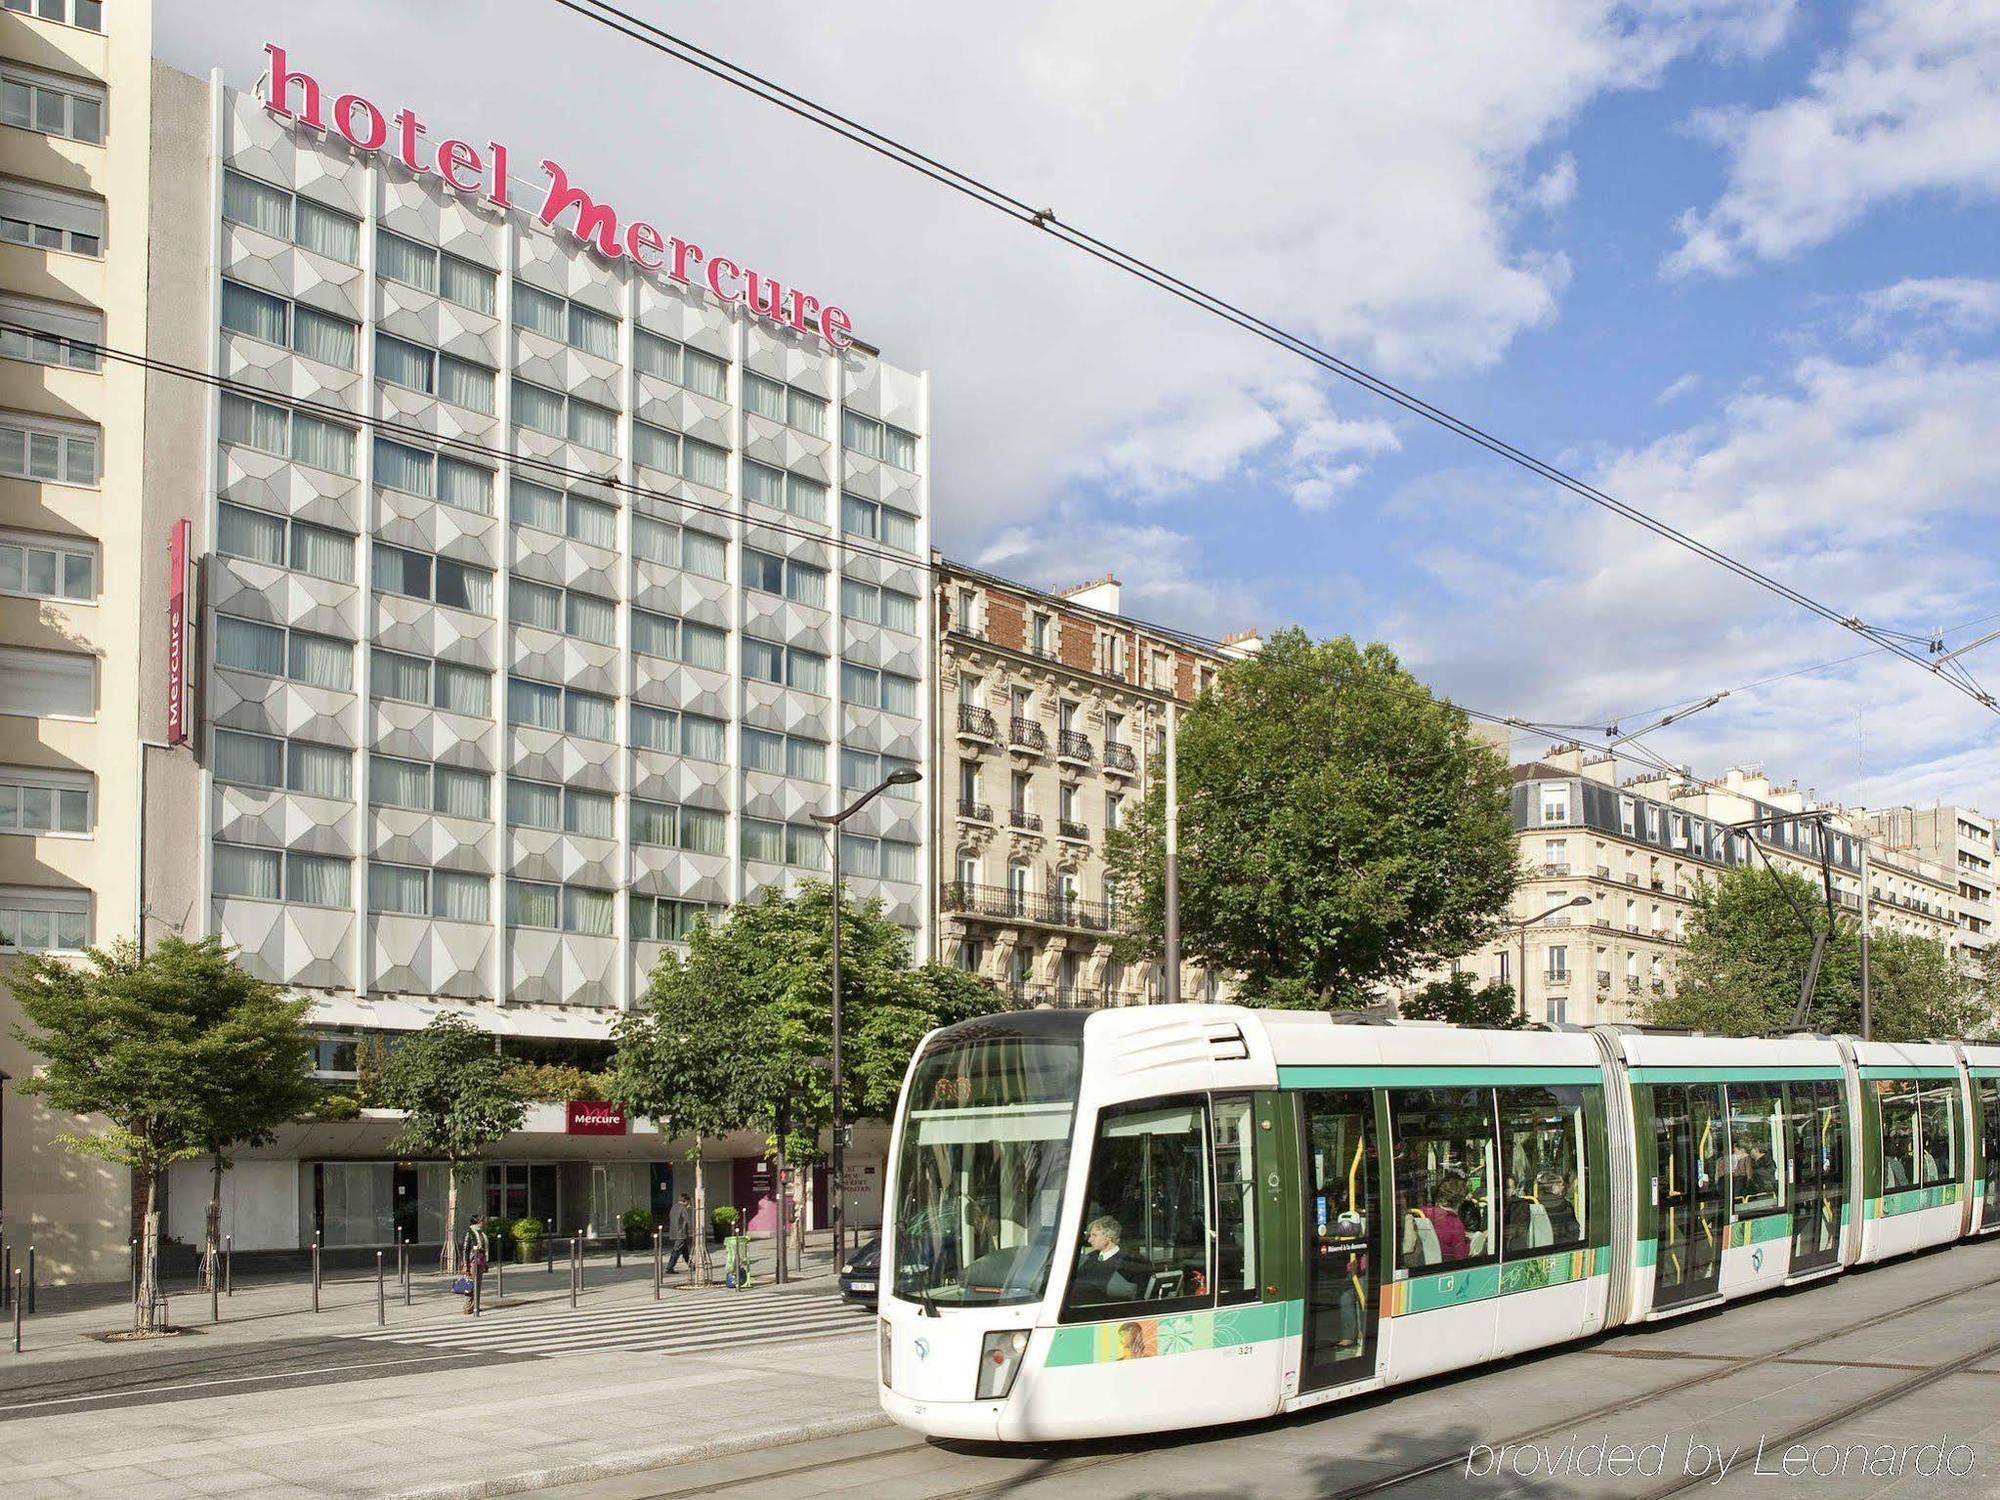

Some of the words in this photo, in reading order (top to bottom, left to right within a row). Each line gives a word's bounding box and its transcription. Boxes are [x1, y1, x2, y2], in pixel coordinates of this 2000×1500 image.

[264, 42, 514, 209] hotel
[169, 612, 180, 726] Mercure
[574, 1114, 621, 1125] Mercure
[1238, 1346, 1253, 1355] 321
